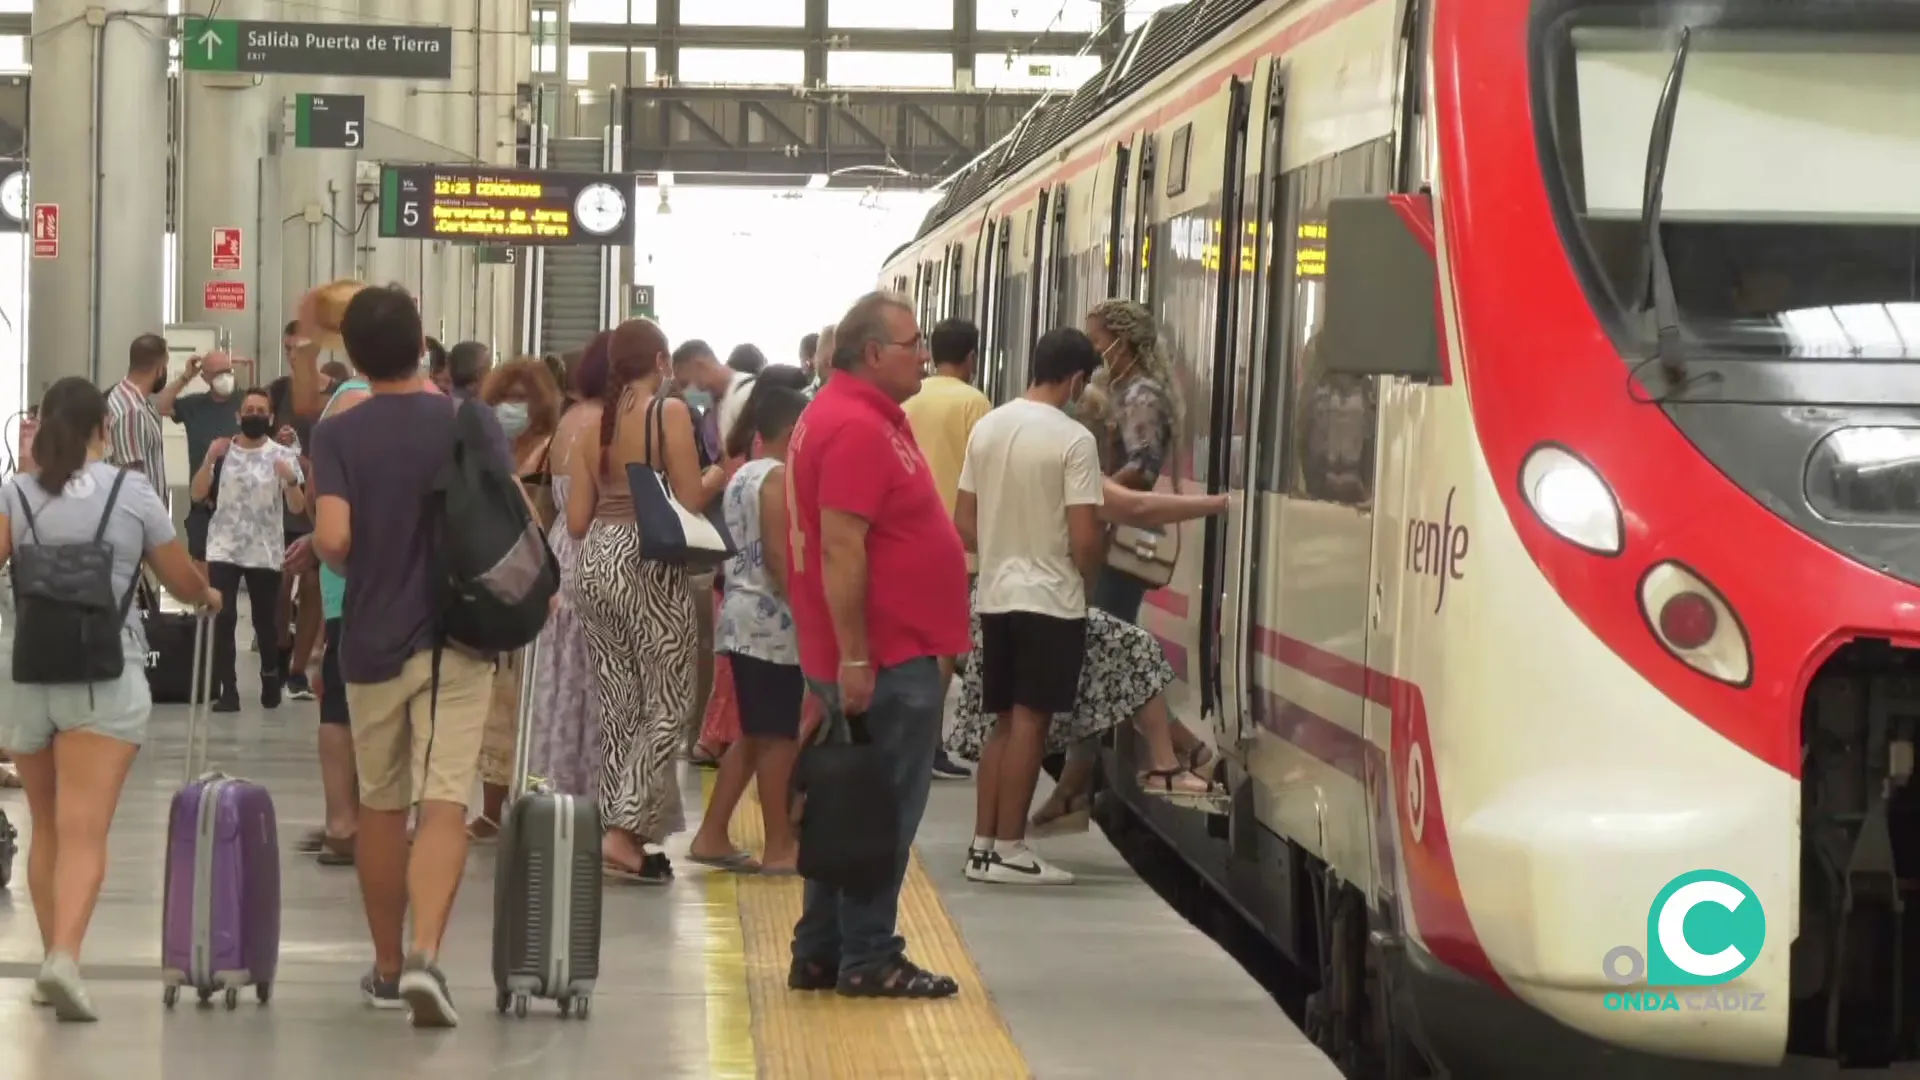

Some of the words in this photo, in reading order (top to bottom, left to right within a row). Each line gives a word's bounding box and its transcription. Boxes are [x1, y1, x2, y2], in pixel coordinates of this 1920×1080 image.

[248, 31, 299, 48] Salida
[306, 33, 360, 50] Puerta
[366, 35, 387, 51] de
[393, 36, 440, 53] Tierra
[247, 52, 266, 61] EXIT
[345, 121, 360, 147] 5
[434, 181, 471, 195] 12:25
[403, 202, 419, 227] 5
[433, 205, 505, 220] Aeropuerto
[510, 209, 525, 220] de
[506, 249, 514, 262] 5
[1406, 486, 1469, 616] renfe
